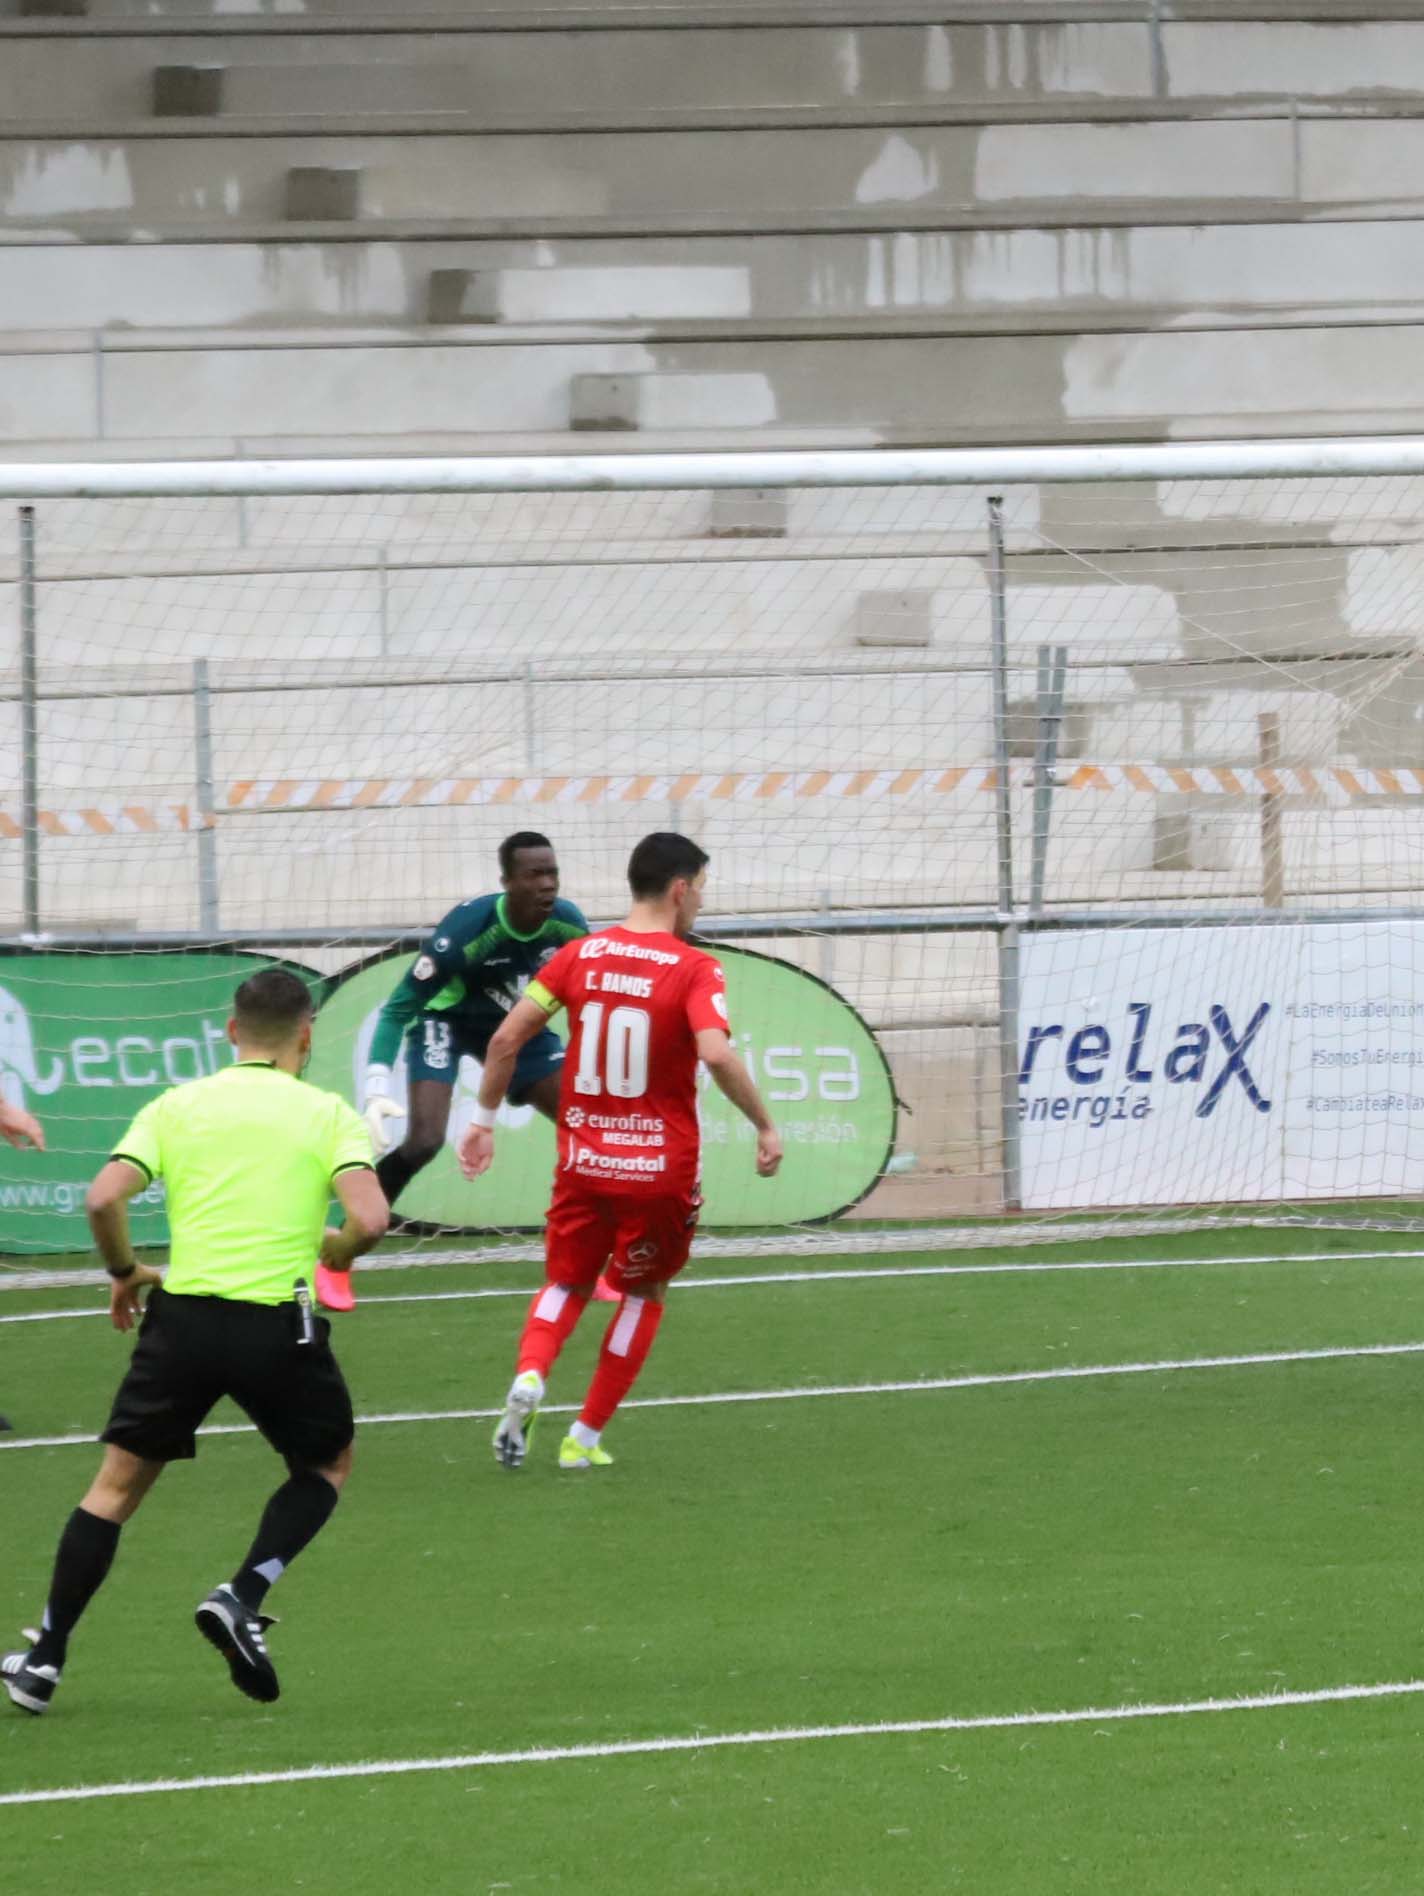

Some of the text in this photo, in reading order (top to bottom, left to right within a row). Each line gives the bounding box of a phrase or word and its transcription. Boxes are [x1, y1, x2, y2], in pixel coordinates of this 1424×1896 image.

[605, 941, 680, 966] AirEuropa
[600, 972, 653, 999] RAMOS
[423, 1019, 451, 1049] 13
[574, 1001, 650, 1098] 10
[588, 1113, 664, 1132] eurofins
[602, 1131, 665, 1147] MEGALAB
[577, 1147, 666, 1172] Pronatal
[575, 1165, 656, 1182] Medical Services
